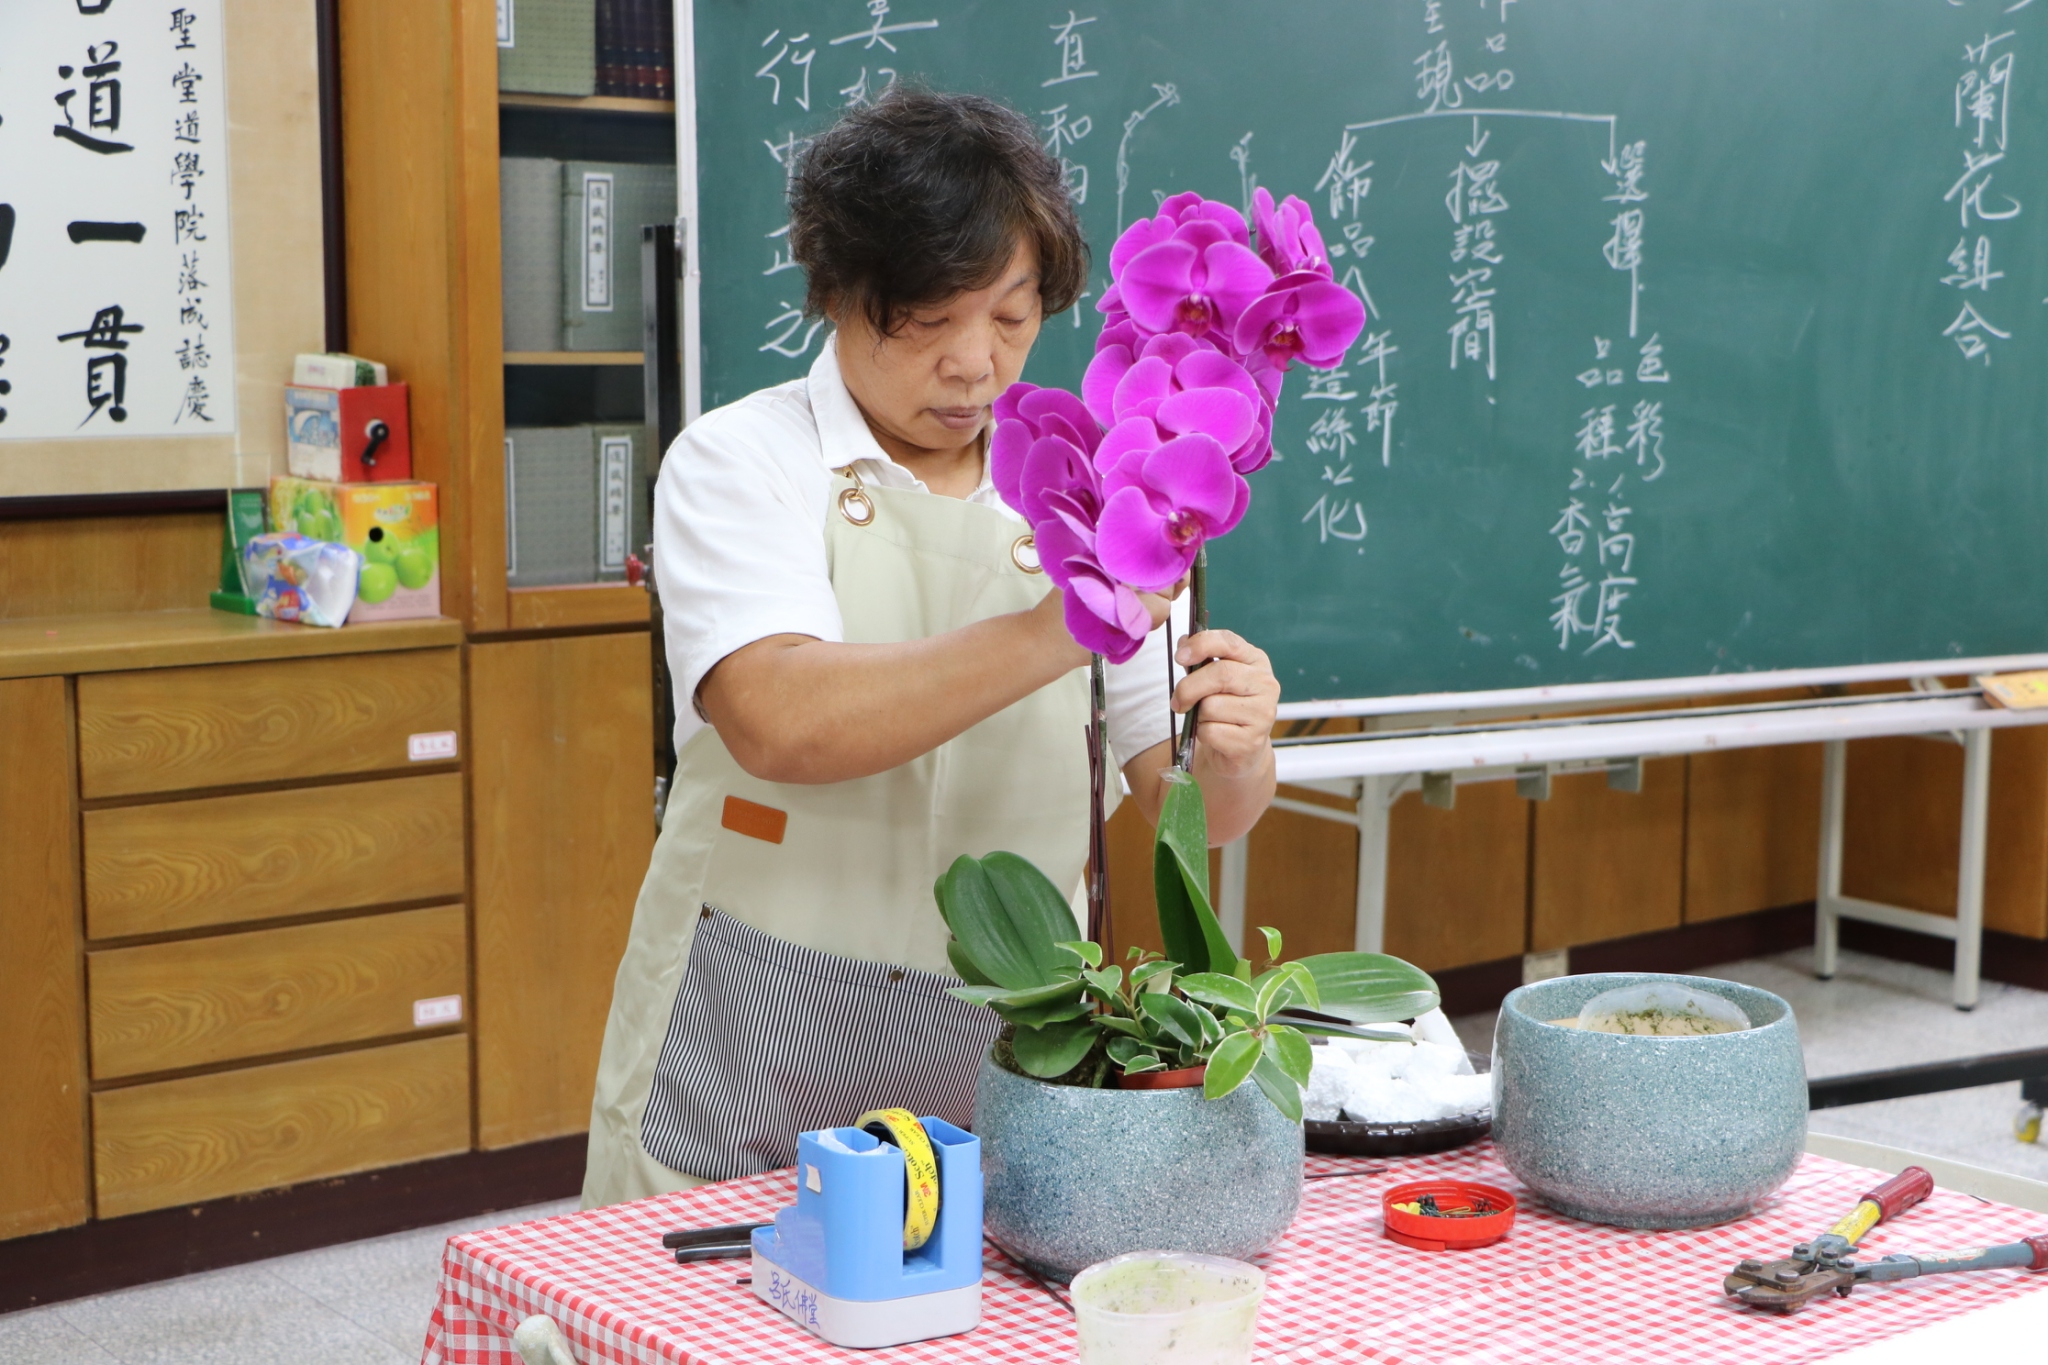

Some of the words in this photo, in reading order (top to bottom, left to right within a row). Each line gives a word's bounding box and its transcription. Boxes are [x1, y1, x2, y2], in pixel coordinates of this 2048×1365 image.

[53, 0, 146, 430] 道一貫
[170, 8, 214, 424] 聖堂道學院落成誌慶
[920, 1181, 931, 1197] 3M
